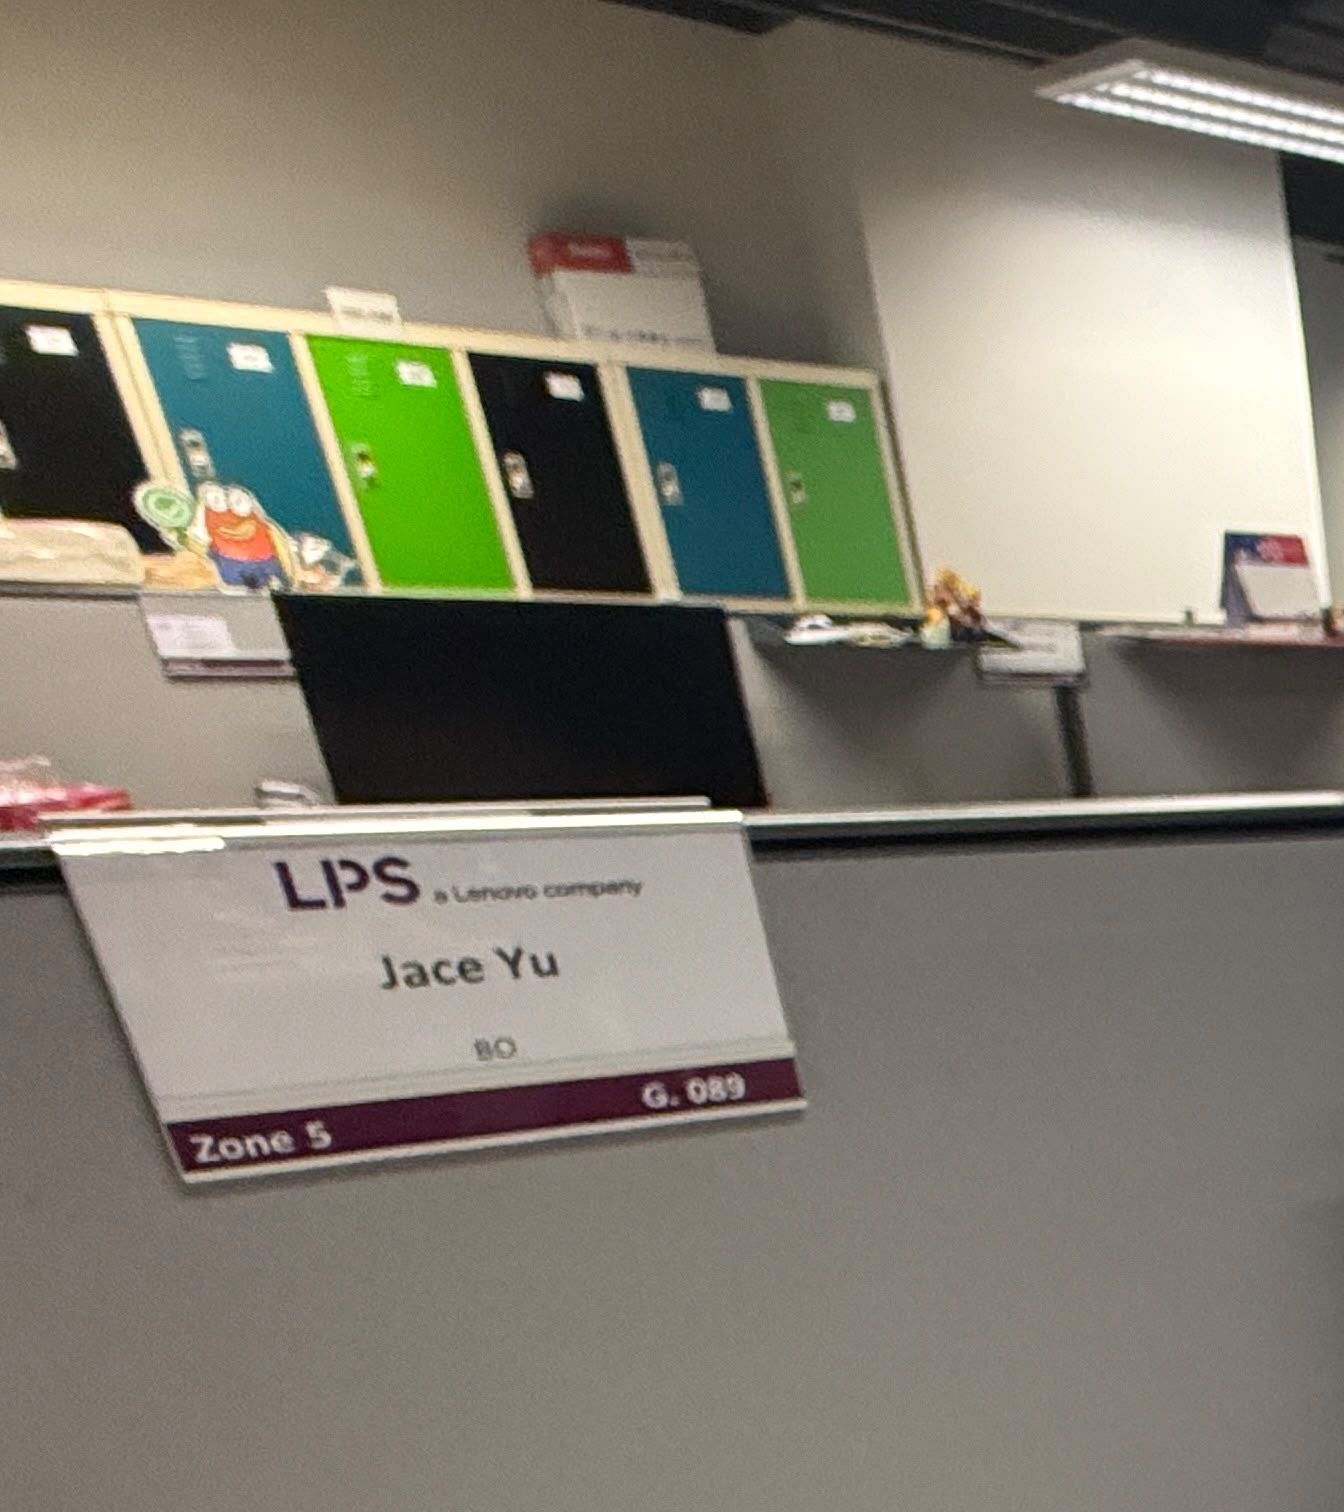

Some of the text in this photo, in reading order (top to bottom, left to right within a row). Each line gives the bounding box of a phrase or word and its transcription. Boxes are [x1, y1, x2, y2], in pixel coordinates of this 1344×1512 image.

[273, 856, 422, 912] LPS
[451, 884, 540, 903] Lenovo
[543, 879, 643, 898] company
[380, 946, 560, 990] Jace Yu
[473, 1036, 518, 1061] BO
[685, 1072, 746, 1104] 089
[189, 1119, 333, 1164] Zone 5
